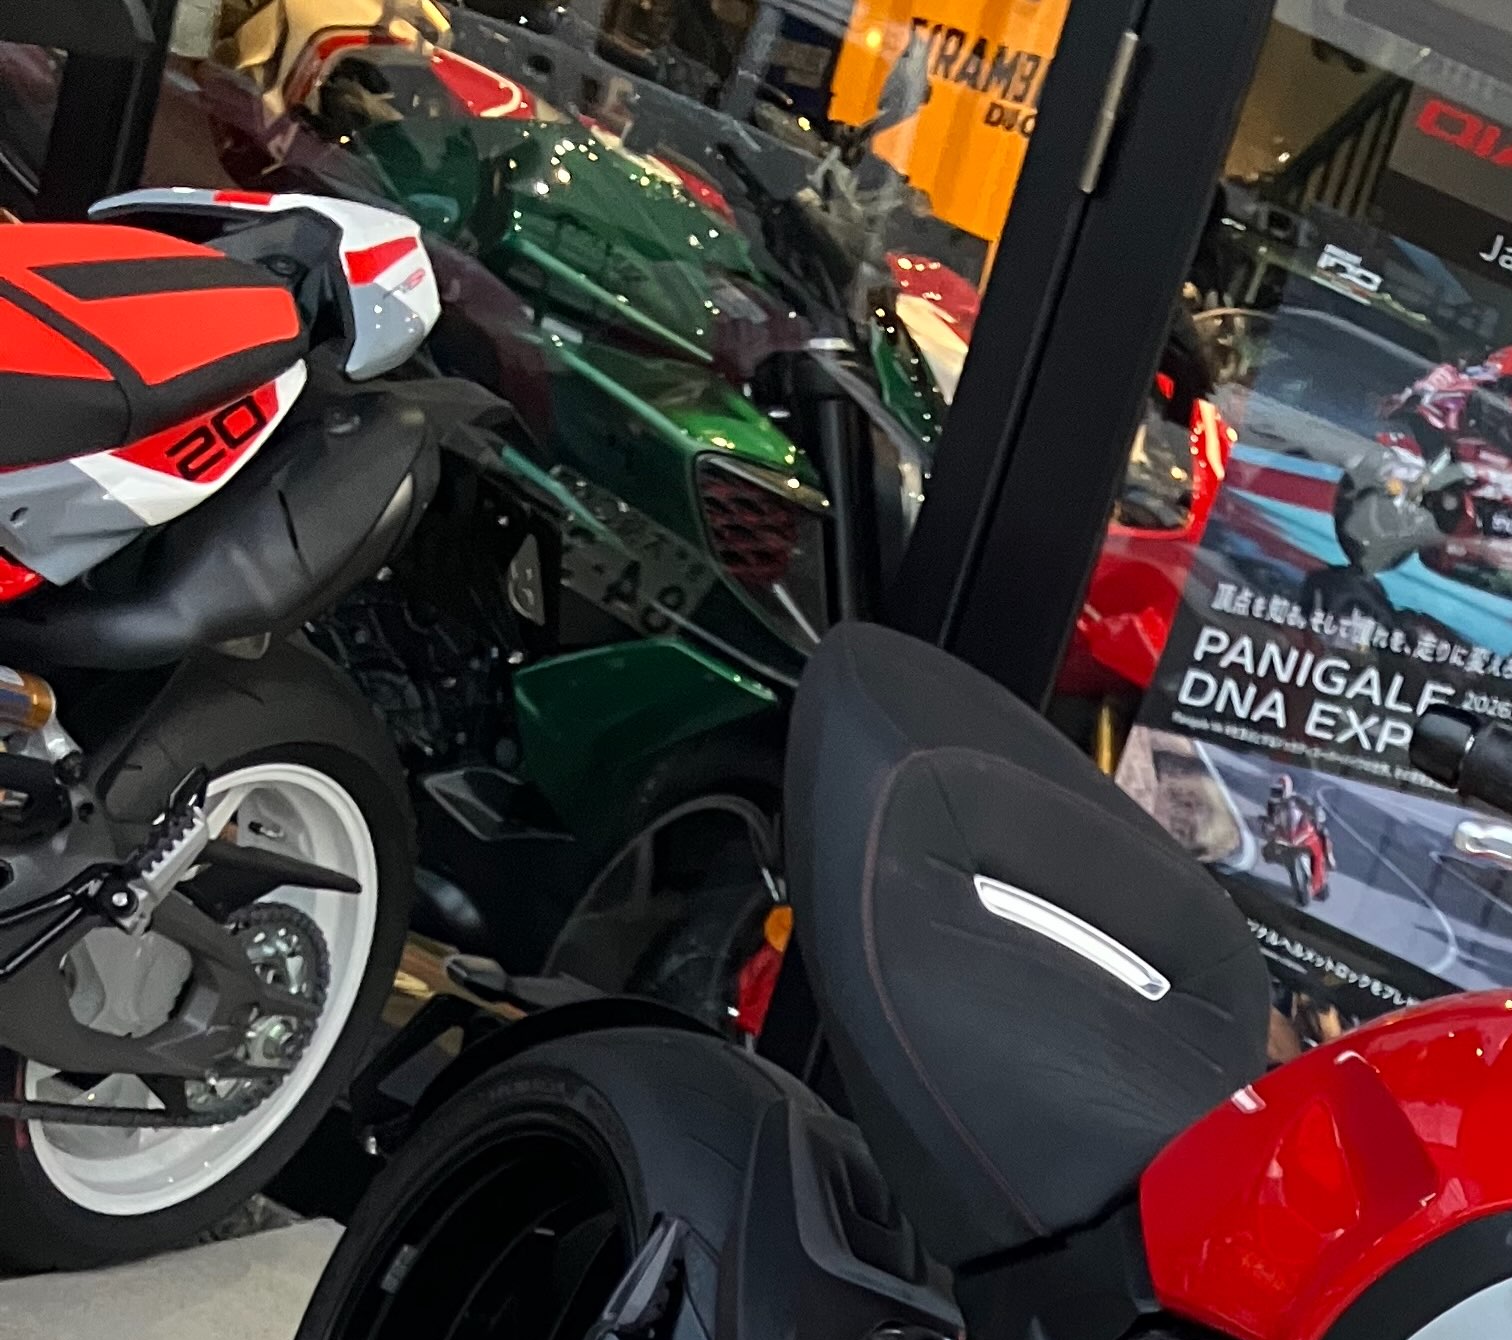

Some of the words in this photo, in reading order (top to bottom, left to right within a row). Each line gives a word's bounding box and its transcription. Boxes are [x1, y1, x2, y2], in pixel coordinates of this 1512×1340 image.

[165, 396, 267, 482] 20
[1177, 669, 1288, 731] DNA
[1304, 704, 1413, 755] EXP
